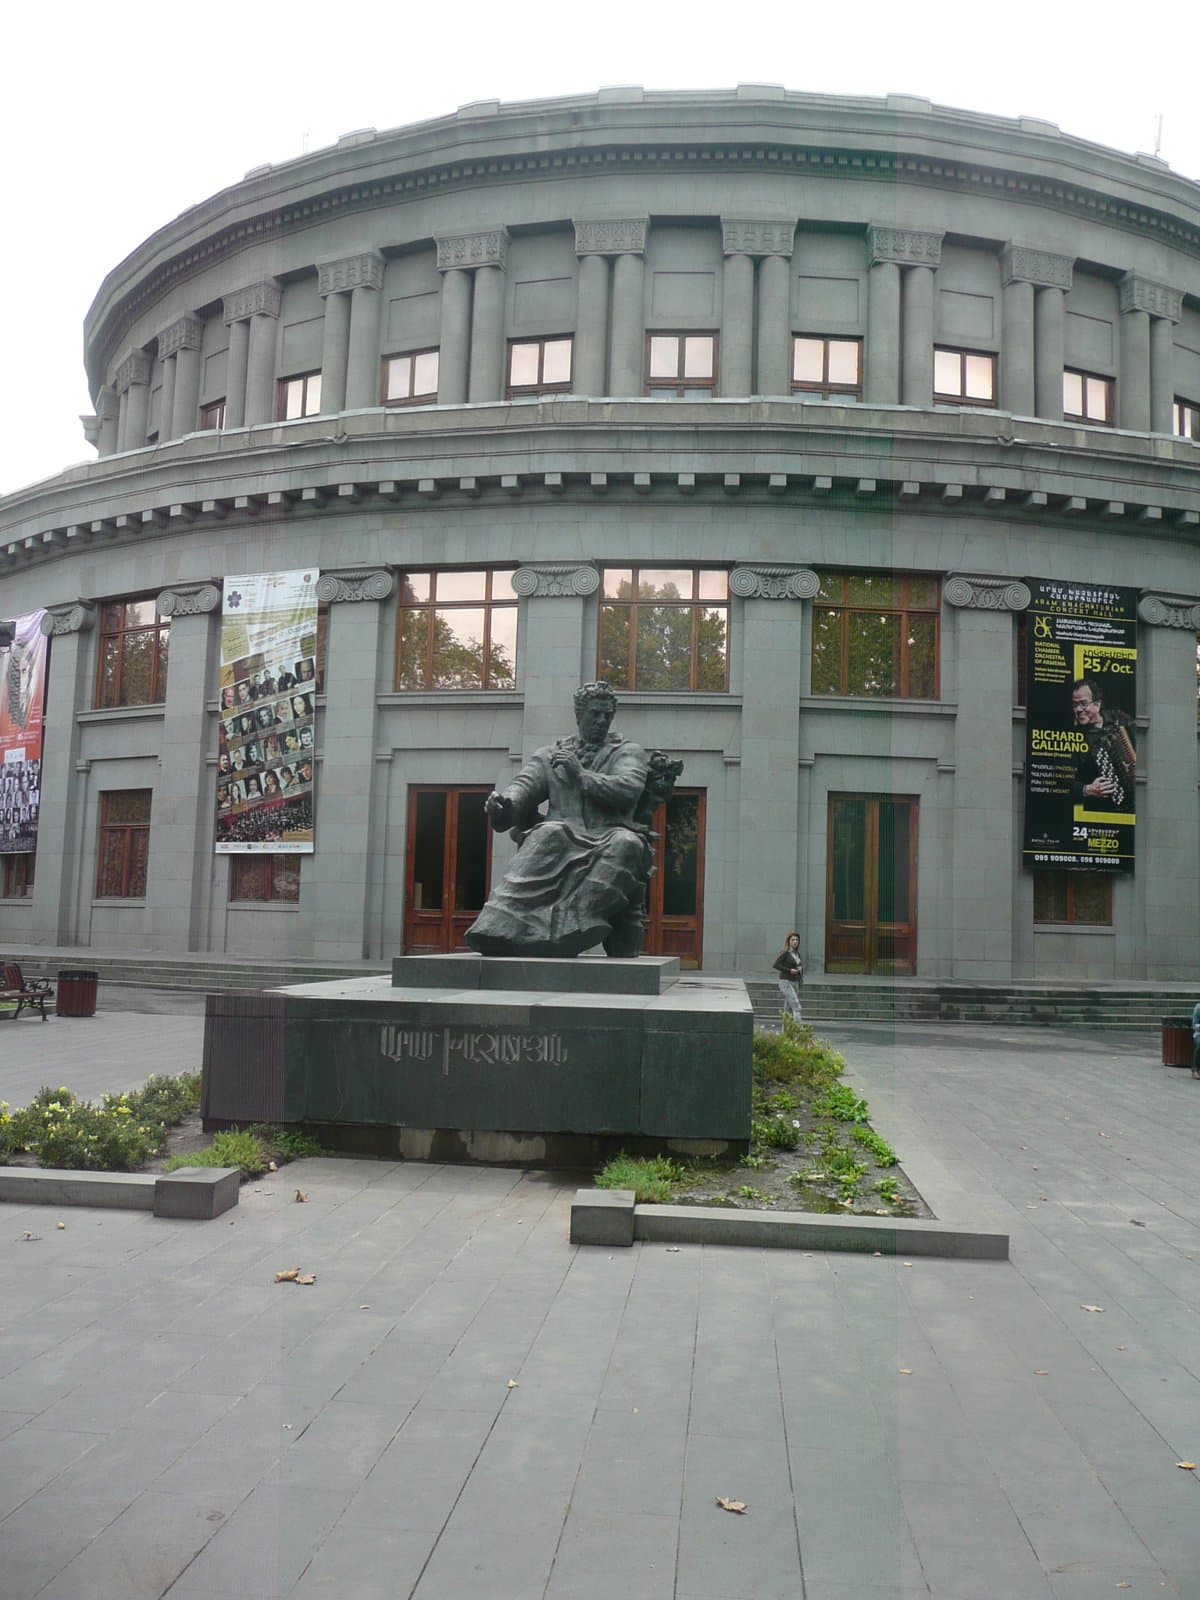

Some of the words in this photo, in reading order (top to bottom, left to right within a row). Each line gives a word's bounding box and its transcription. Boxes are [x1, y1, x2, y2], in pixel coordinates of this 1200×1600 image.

[1084, 658, 1101, 672] 25
[1112, 663, 1134, 674] Oct.
[1032, 729, 1085, 743] RICHARD
[1032, 740, 1089, 753] GALLIANO
[1073, 827, 1088, 839] 24
[1088, 838, 1120, 848] MEZZO
